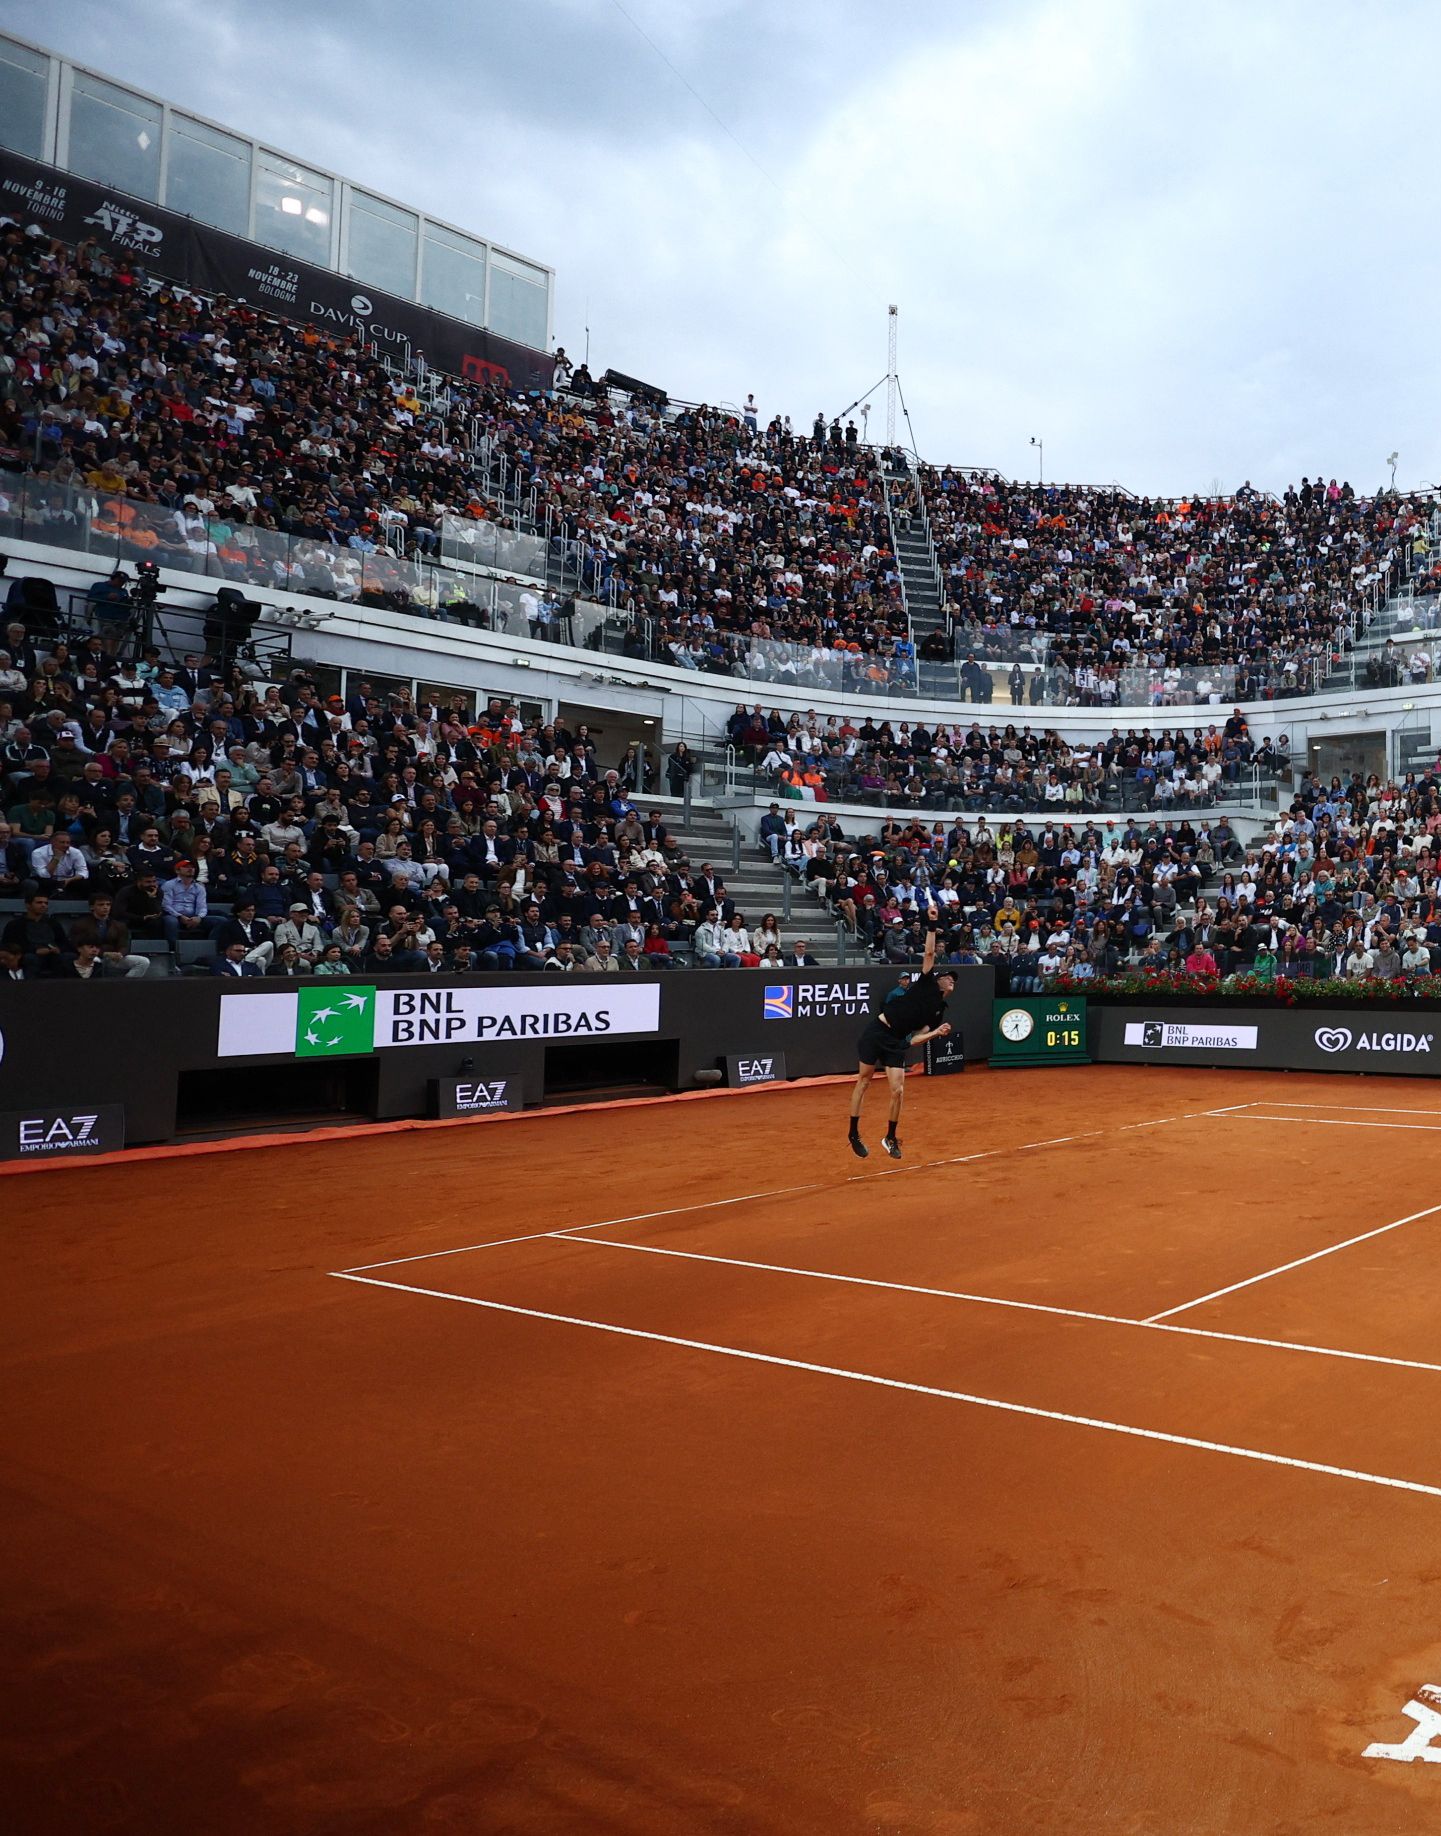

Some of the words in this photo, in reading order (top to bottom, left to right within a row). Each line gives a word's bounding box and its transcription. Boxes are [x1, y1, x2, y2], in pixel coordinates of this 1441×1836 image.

[3, 180, 66, 210] NOVEMBRE
[35, 179, 43, 190] 9
[53, 187, 67, 198] 16
[27, 201, 65, 221] TORINO
[102, 201, 139, 220] Nitto
[82, 207, 163, 243] ATP
[112, 234, 161, 258] FINALS
[248, 269, 298, 293] NOVEMBRE
[268, 265, 279, 276] 18
[286, 272, 299, 283] 23
[258, 284, 296, 304] BOLOGNA
[310, 301, 364, 329] DAVIS
[370, 324, 408, 344] CUP
[798, 983, 870, 1002] REALE
[392, 992, 464, 1016] BNL
[797, 1002, 870, 1017] MUTUA
[391, 1017, 466, 1042] BNP
[477, 1010, 611, 1038] PARIBAS
[1046, 1014, 1080, 1022] ROLEX
[1047, 1031, 1079, 1046] 0:15
[1168, 1026, 1188, 1035] BNL
[1167, 1036, 1188, 1046] BNP
[1191, 1037, 1238, 1047] PARIBAS
[738, 1059, 773, 1077] EA7
[456, 1081, 507, 1103] EA7
[20, 1115, 98, 1144] EA7
[20, 1143, 58, 1152] EMPORIO
[69, 1138, 99, 1147] ARMANI
